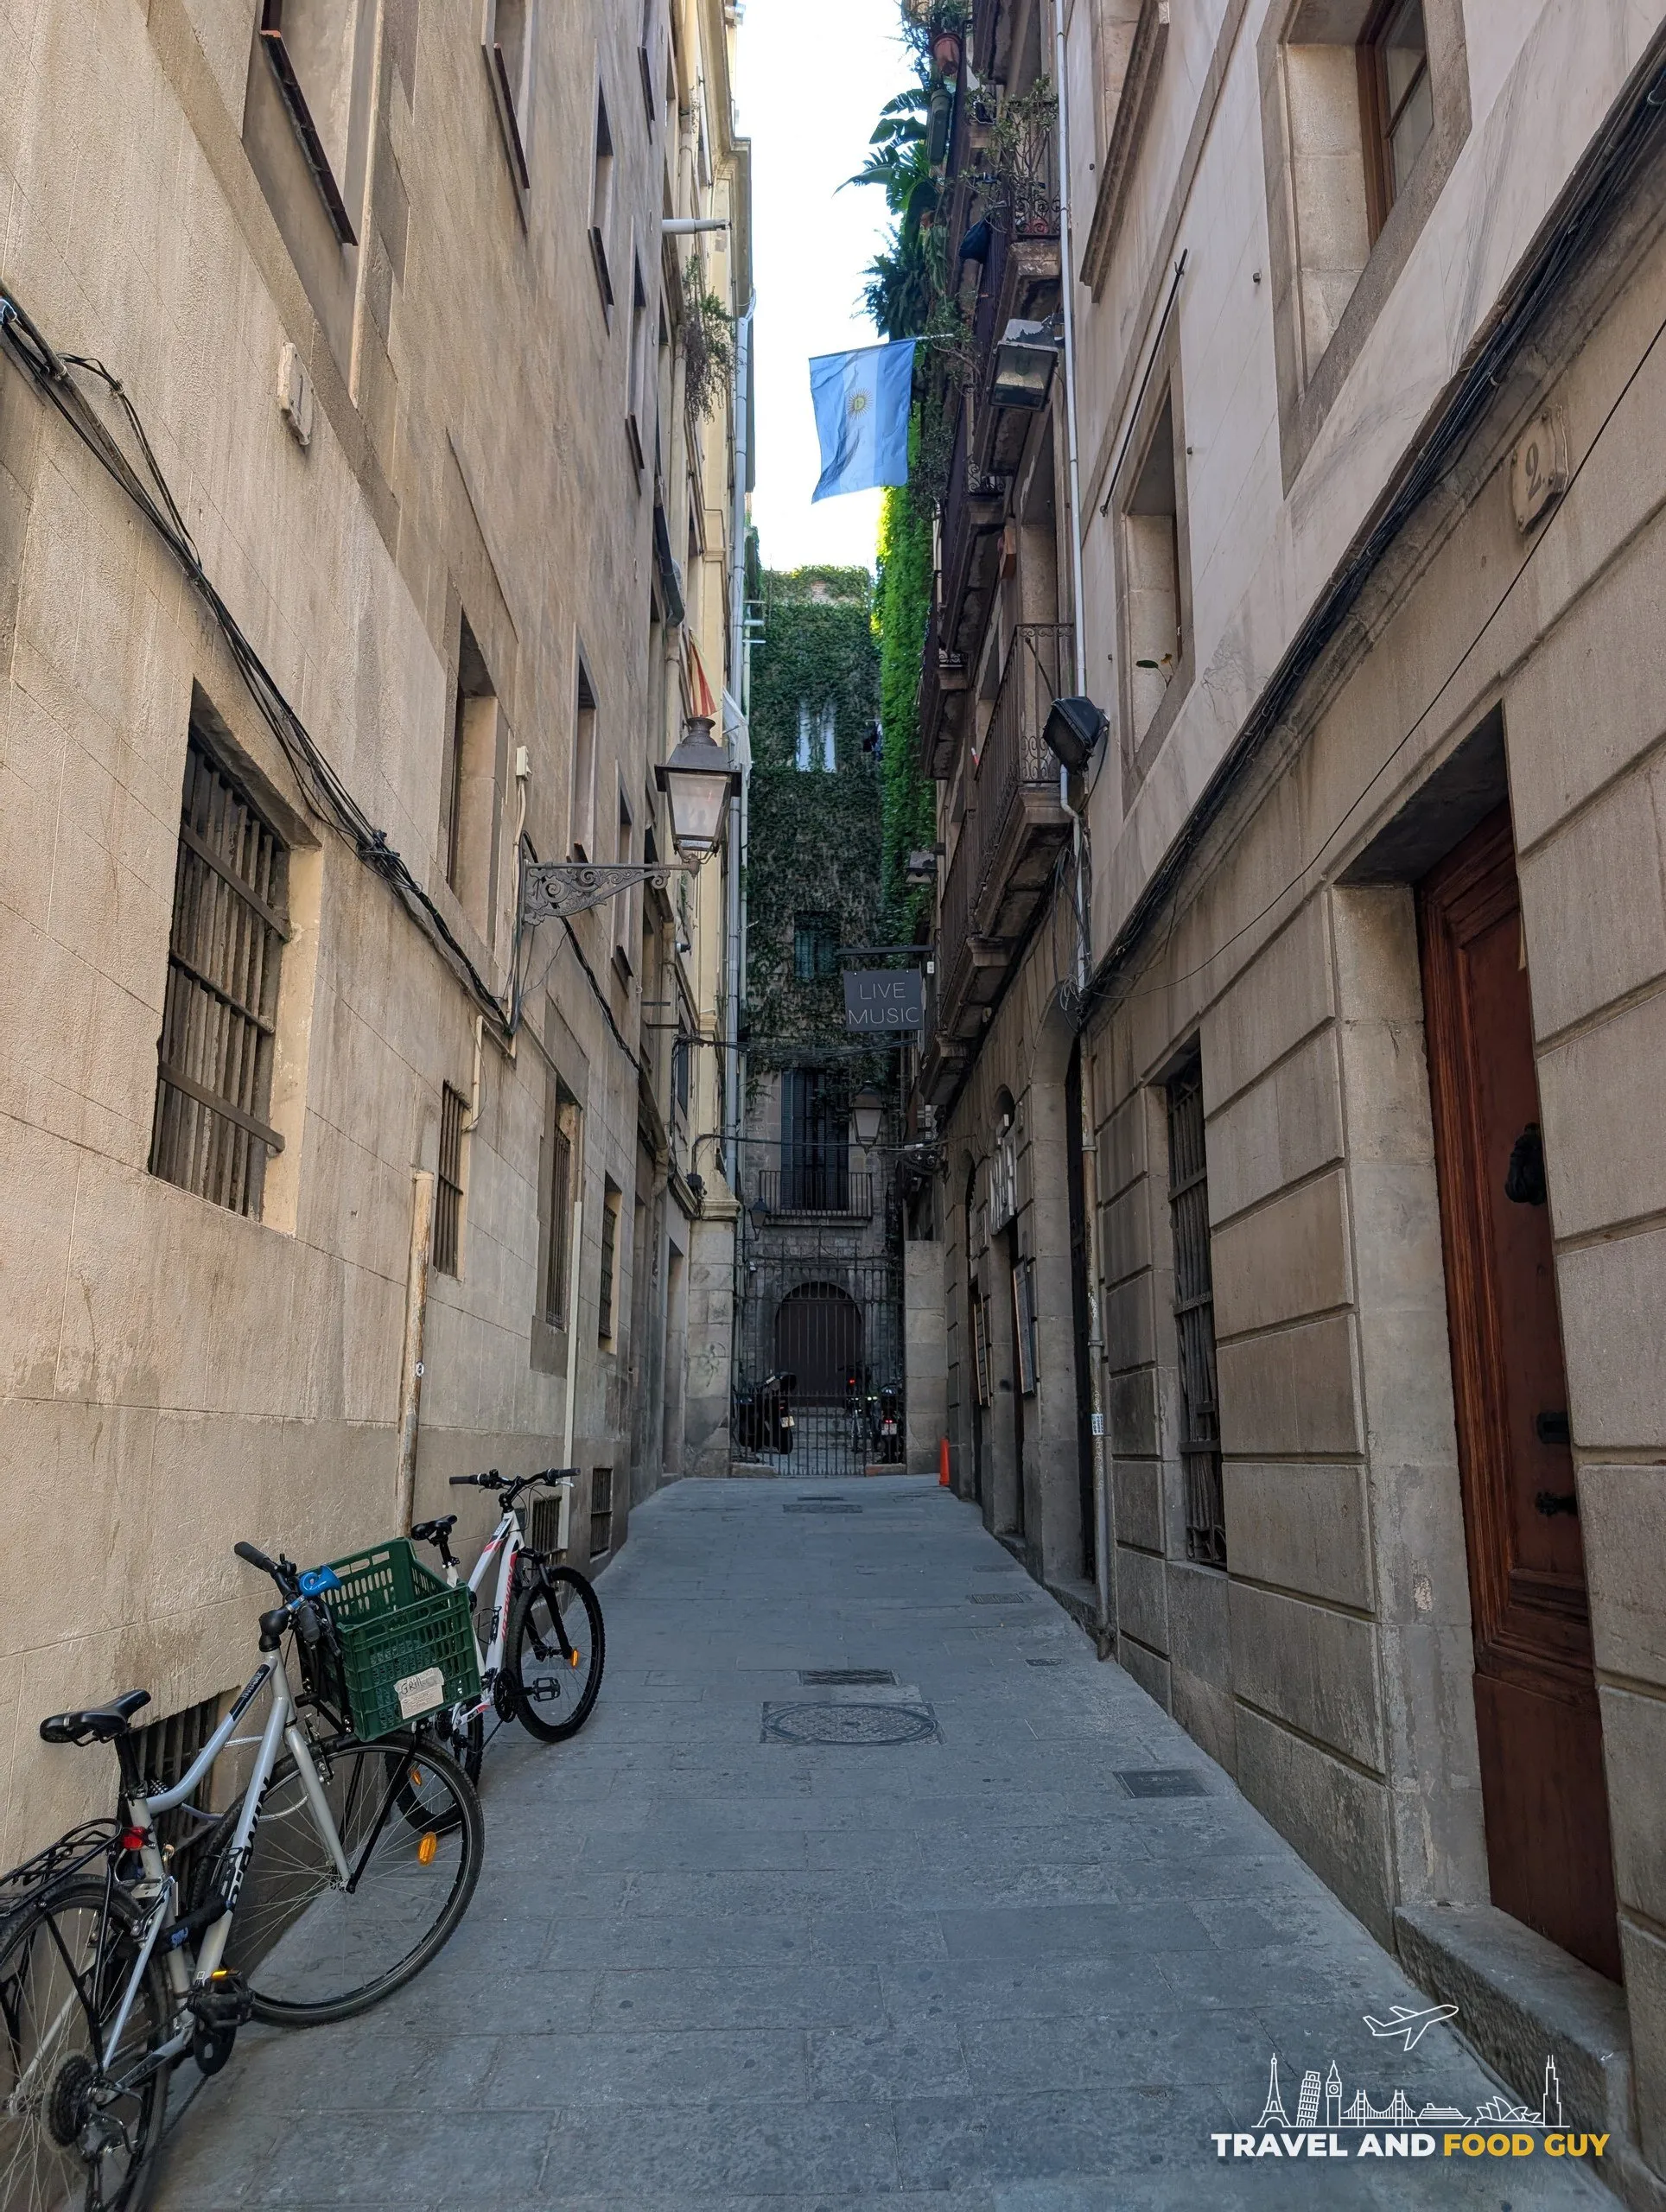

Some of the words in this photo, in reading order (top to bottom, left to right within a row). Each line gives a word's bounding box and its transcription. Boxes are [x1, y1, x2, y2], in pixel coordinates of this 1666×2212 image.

[1525, 442, 1542, 502] 2
[860, 982, 906, 1000] LIVE
[849, 1007, 919, 1025] MUSIC
